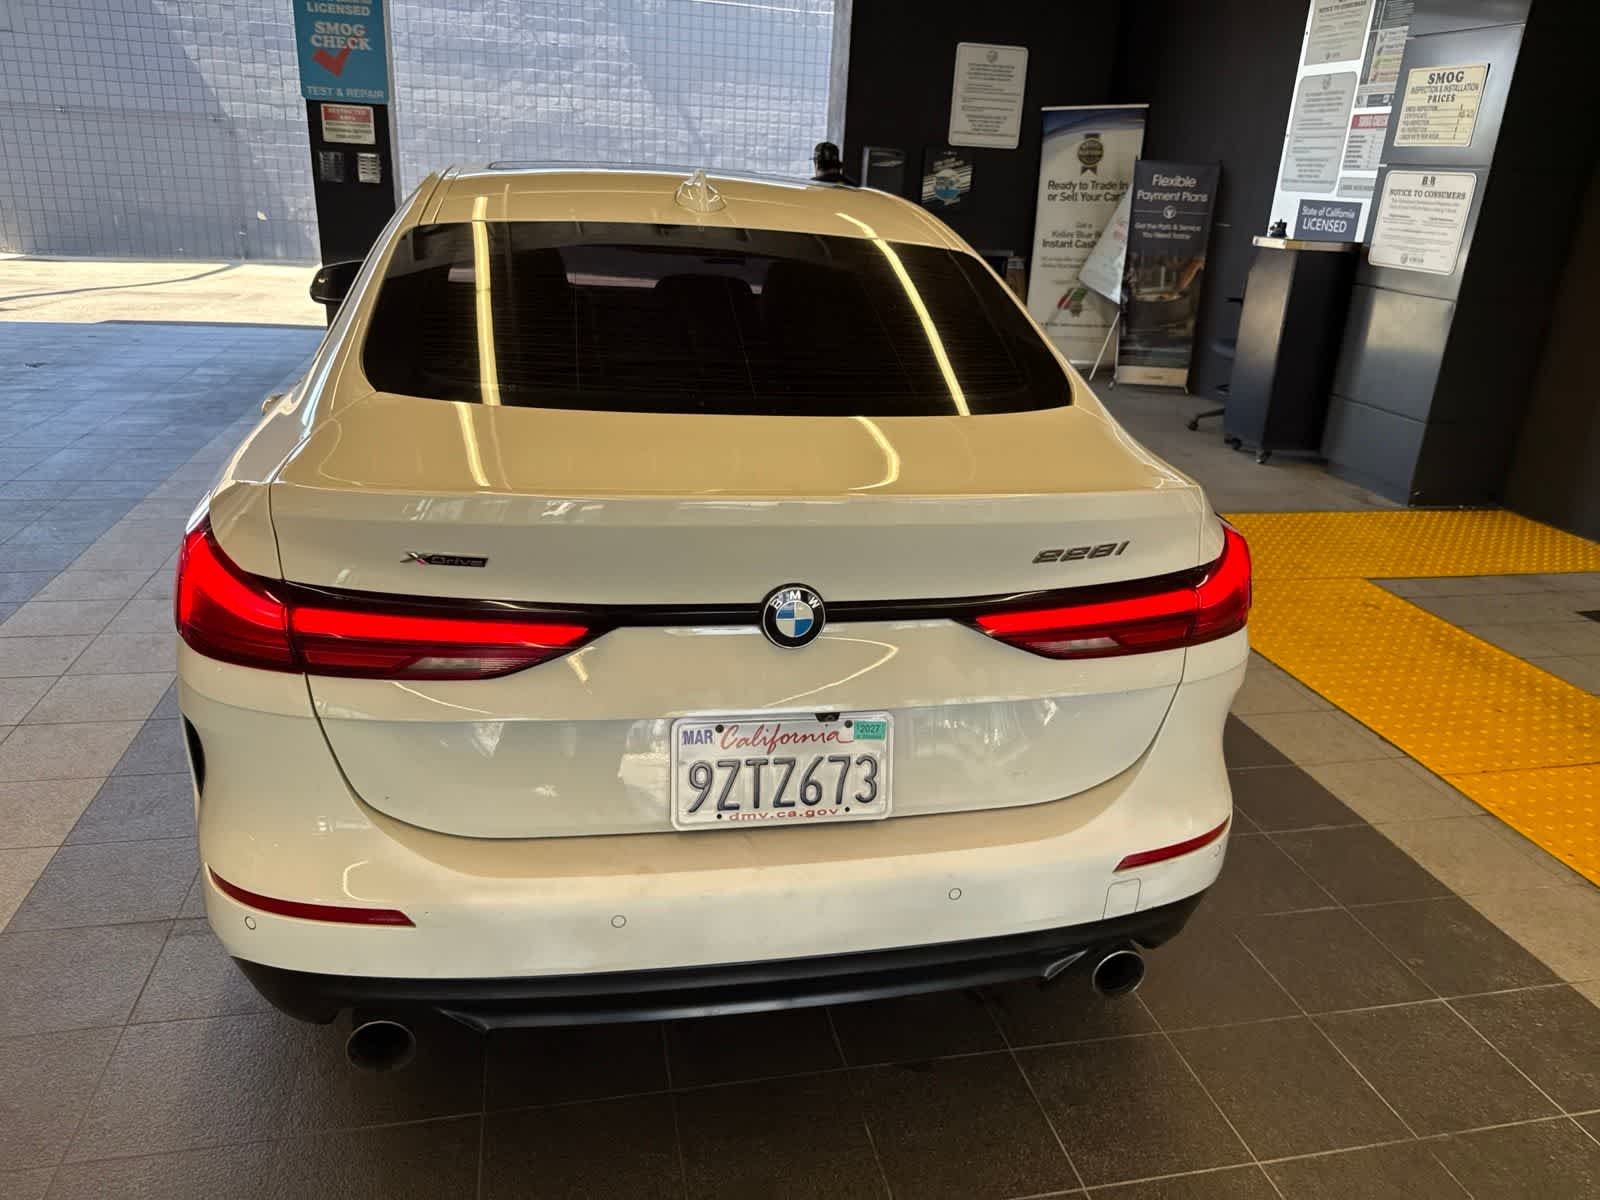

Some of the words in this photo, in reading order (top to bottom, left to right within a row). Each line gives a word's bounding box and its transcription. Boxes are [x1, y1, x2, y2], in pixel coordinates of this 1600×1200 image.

[306, 2, 371, 16] LICENSED
[314, 21, 366, 36] SMOG
[310, 34, 373, 50] CHECK
[1427, 71, 1465, 85] SMOG
[307, 86, 334, 96] TEST
[336, 88, 344, 97] &
[346, 88, 385, 98] REPAIR
[1427, 94, 1456, 103] PRICES
[1048, 180, 1077, 192] Ready
[1080, 181, 1089, 190] to
[1091, 181, 1117, 190] Trade
[1152, 174, 1197, 188] Flexible
[1047, 193, 1058, 201] or
[1060, 192, 1078, 201] Sell
[1080, 192, 1103, 201] Your
[1136, 189, 1181, 202] Payment
[1182, 191, 1208, 202] Plans
[1390, 189, 1413, 197] NOTICE
[1414, 190, 1423, 198] TO
[1424, 190, 1466, 200] CONSUMERS
[1301, 205, 1317, 216] State
[1318, 206, 1325, 216] of
[1326, 207, 1355, 219] California
[1302, 218, 1347, 233] LICENSED
[1042, 239, 1072, 248] Instant
[769, 590, 820, 610] BMW
[681, 729, 713, 746] MAR
[719, 723, 854, 754] California
[858, 722, 881, 733] 2027
[688, 754, 878, 813] 9ZTZ673
[729, 807, 839, 822] dmv.ca.gov
